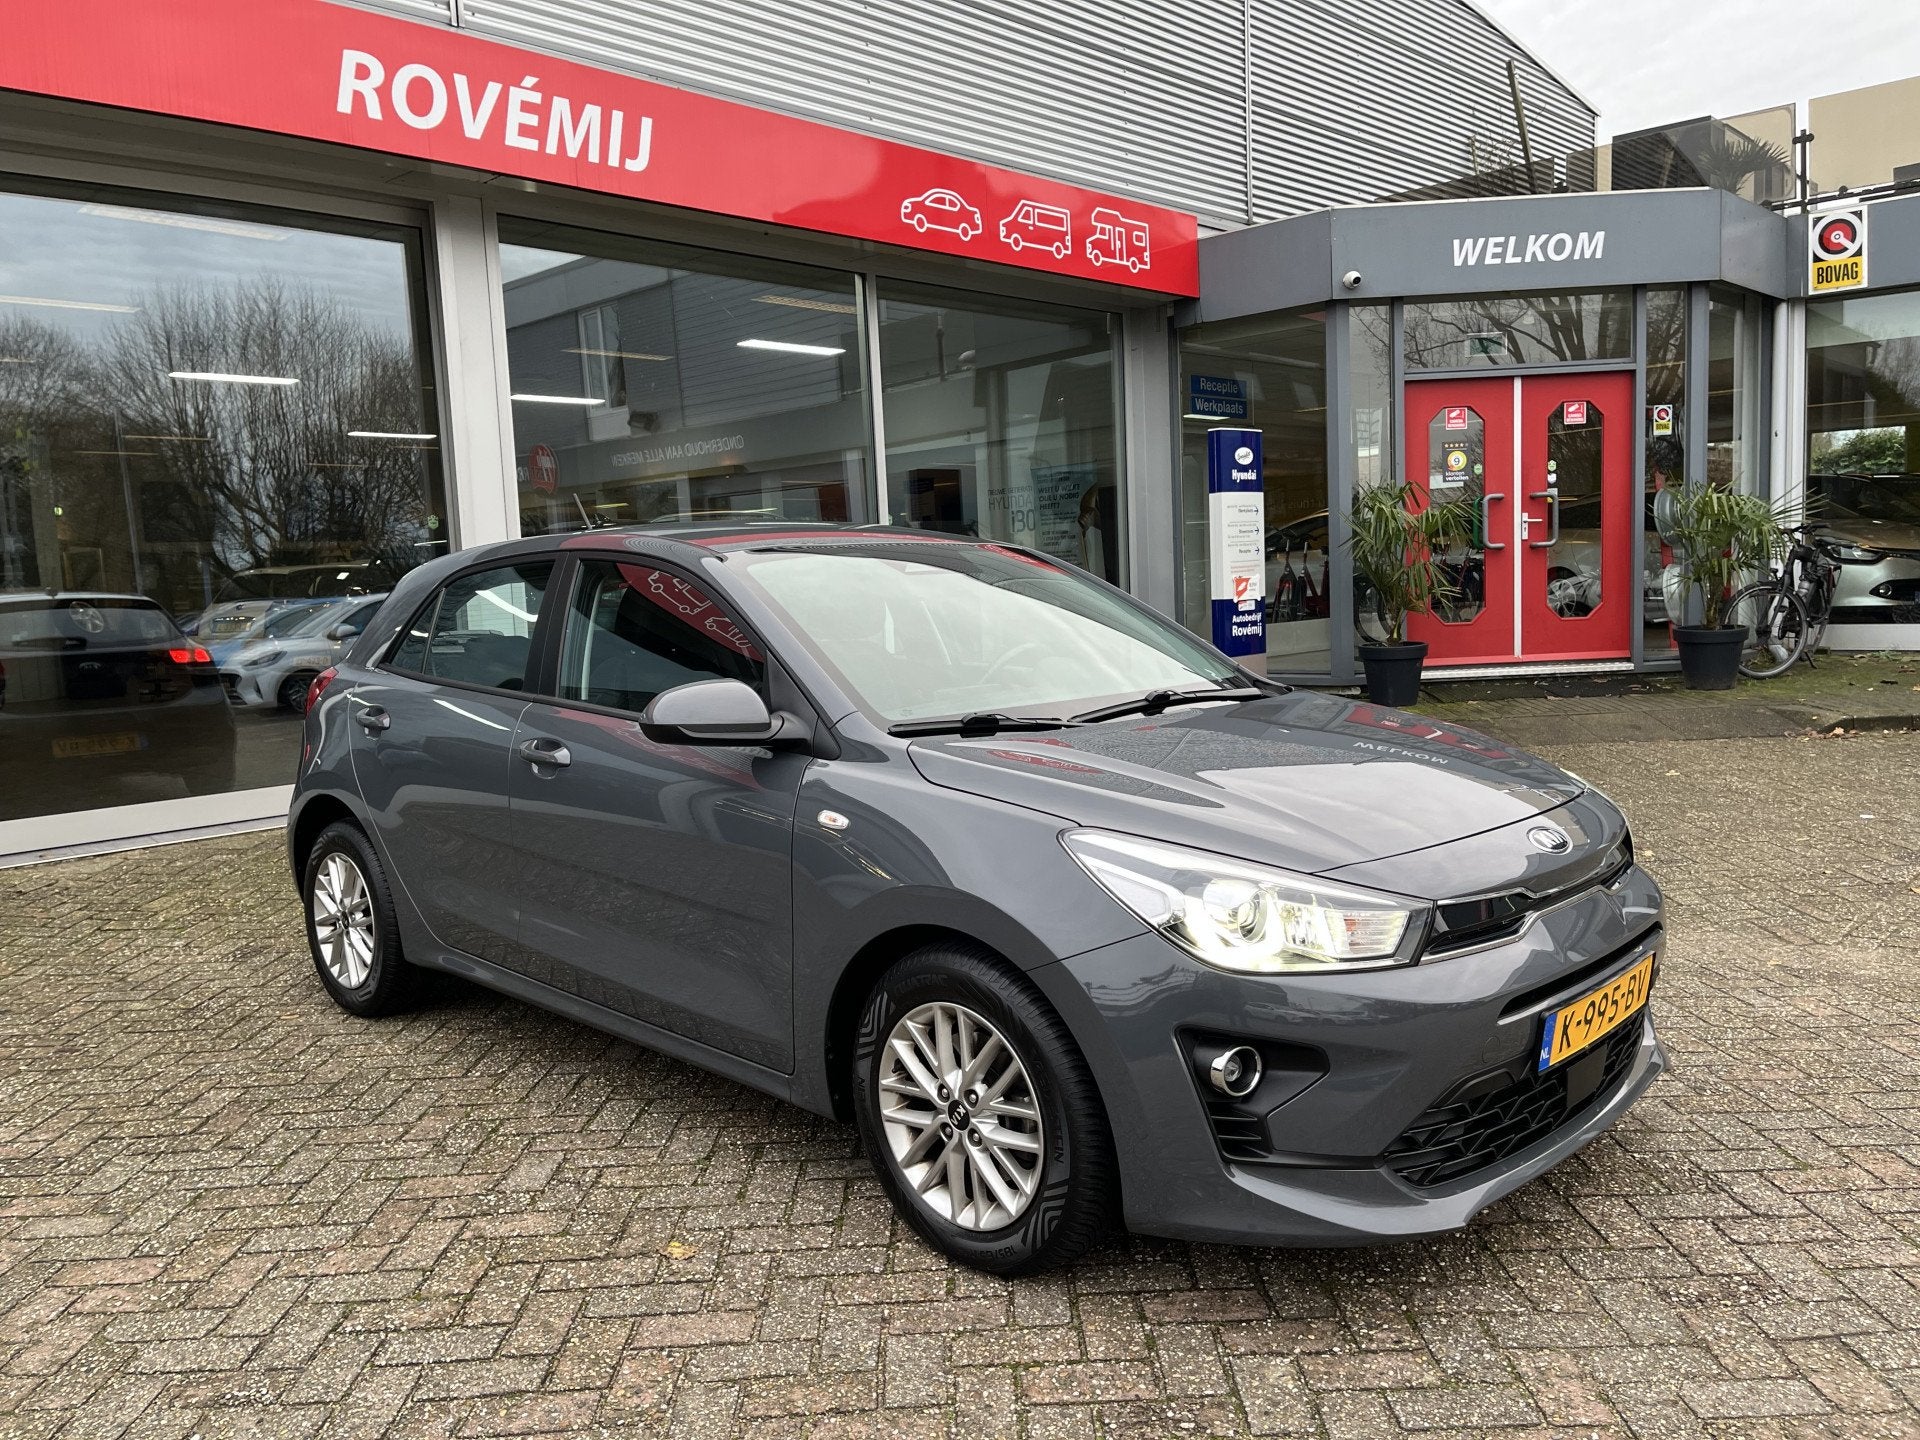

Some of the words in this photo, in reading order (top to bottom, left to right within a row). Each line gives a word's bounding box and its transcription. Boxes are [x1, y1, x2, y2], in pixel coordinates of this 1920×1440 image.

[336, 49, 653, 172] ROVÉMIJ
[1453, 231, 1605, 267] WELKOM
[1817, 261, 1859, 285] BOVAG
[1200, 378, 1239, 394] Receptie
[1195, 398, 1243, 414] Werkplaats
[1453, 457, 1460, 465] 9
[1232, 469, 1257, 483] Hyundai
[1011, 509, 1036, 532] i30
[1232, 612, 1262, 623] Autobedrijf
[1232, 623, 1262, 637] Rovémij
[1558, 964, 1648, 1054] K-995-BV
[1540, 1047, 1550, 1061] NL
[951, 1104, 967, 1126] KIA
